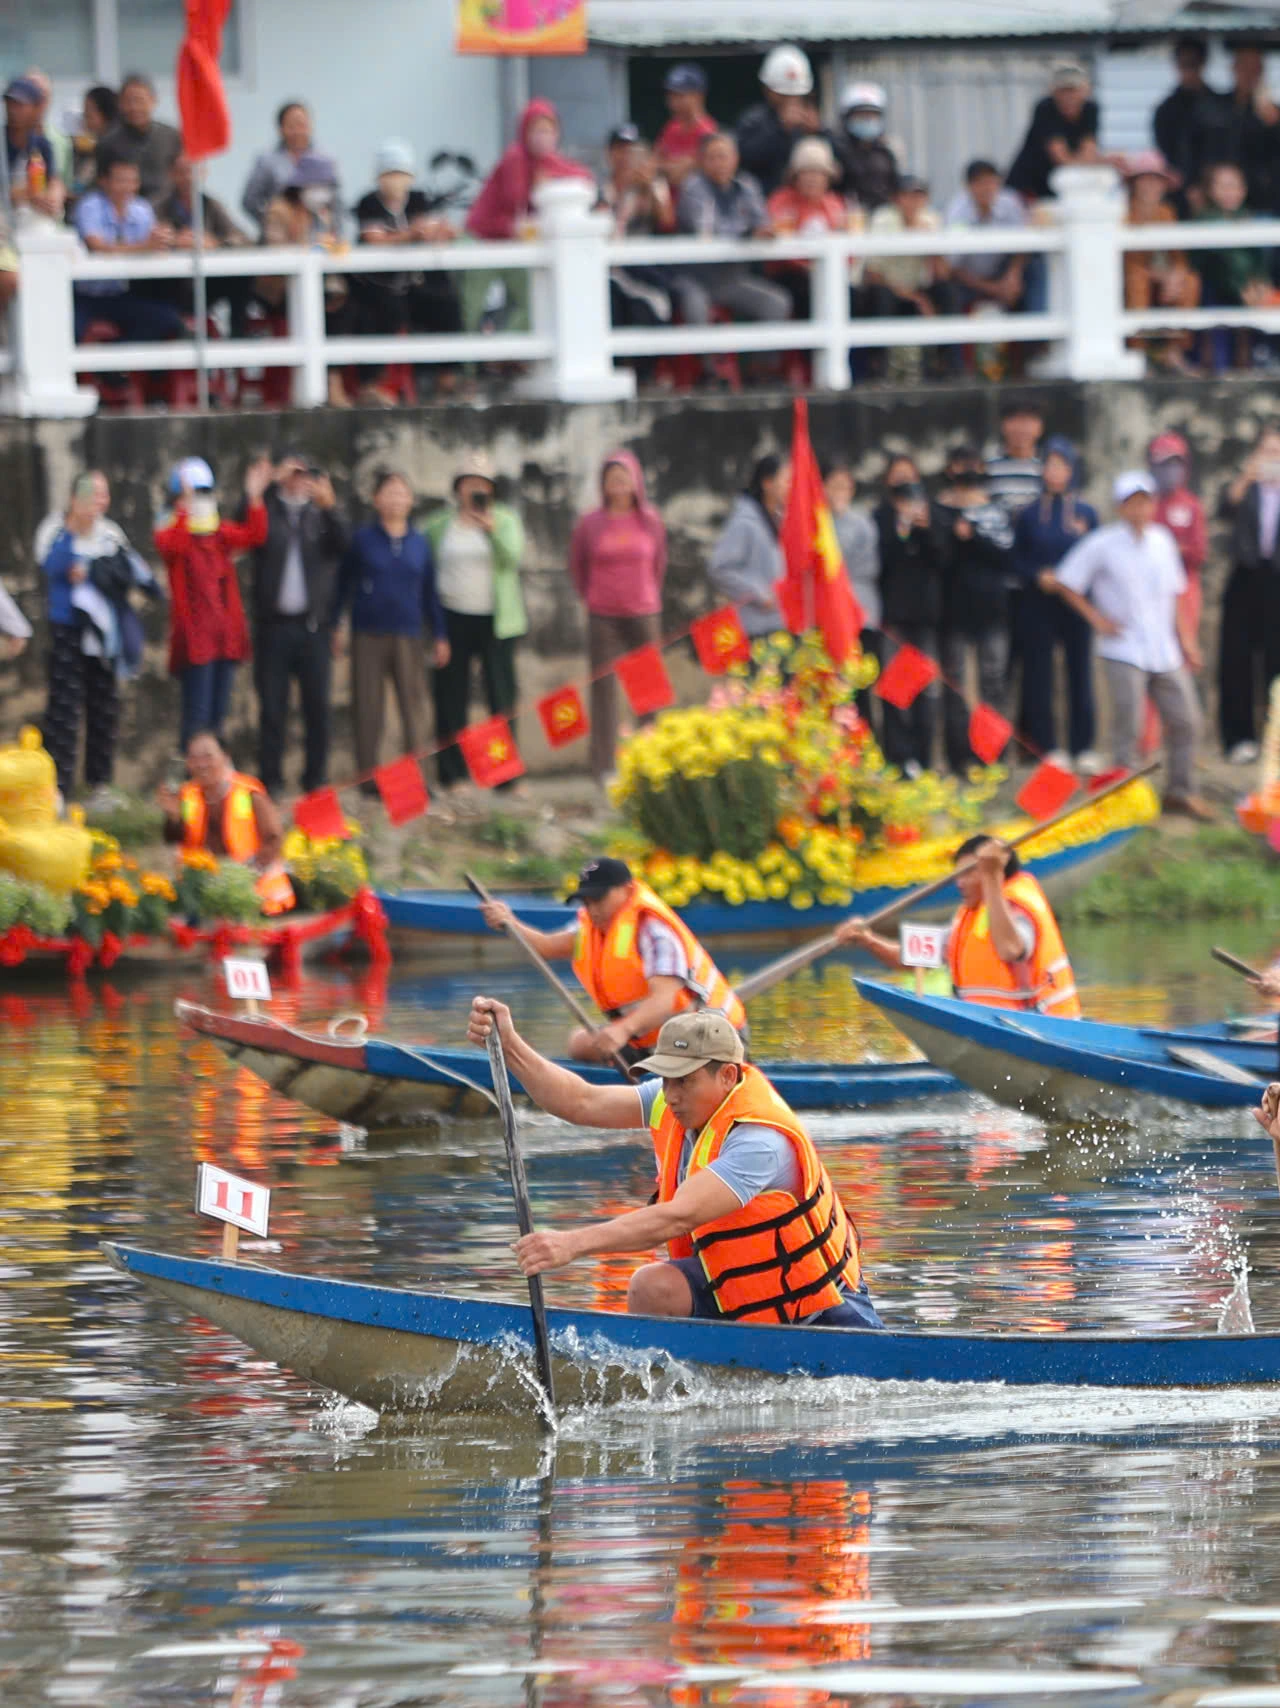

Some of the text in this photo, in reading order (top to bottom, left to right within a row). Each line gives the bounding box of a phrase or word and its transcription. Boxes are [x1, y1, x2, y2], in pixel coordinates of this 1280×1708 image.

[907, 934, 936, 960] 05
[232, 968, 262, 992] 01
[211, 1179, 257, 1224] 11
